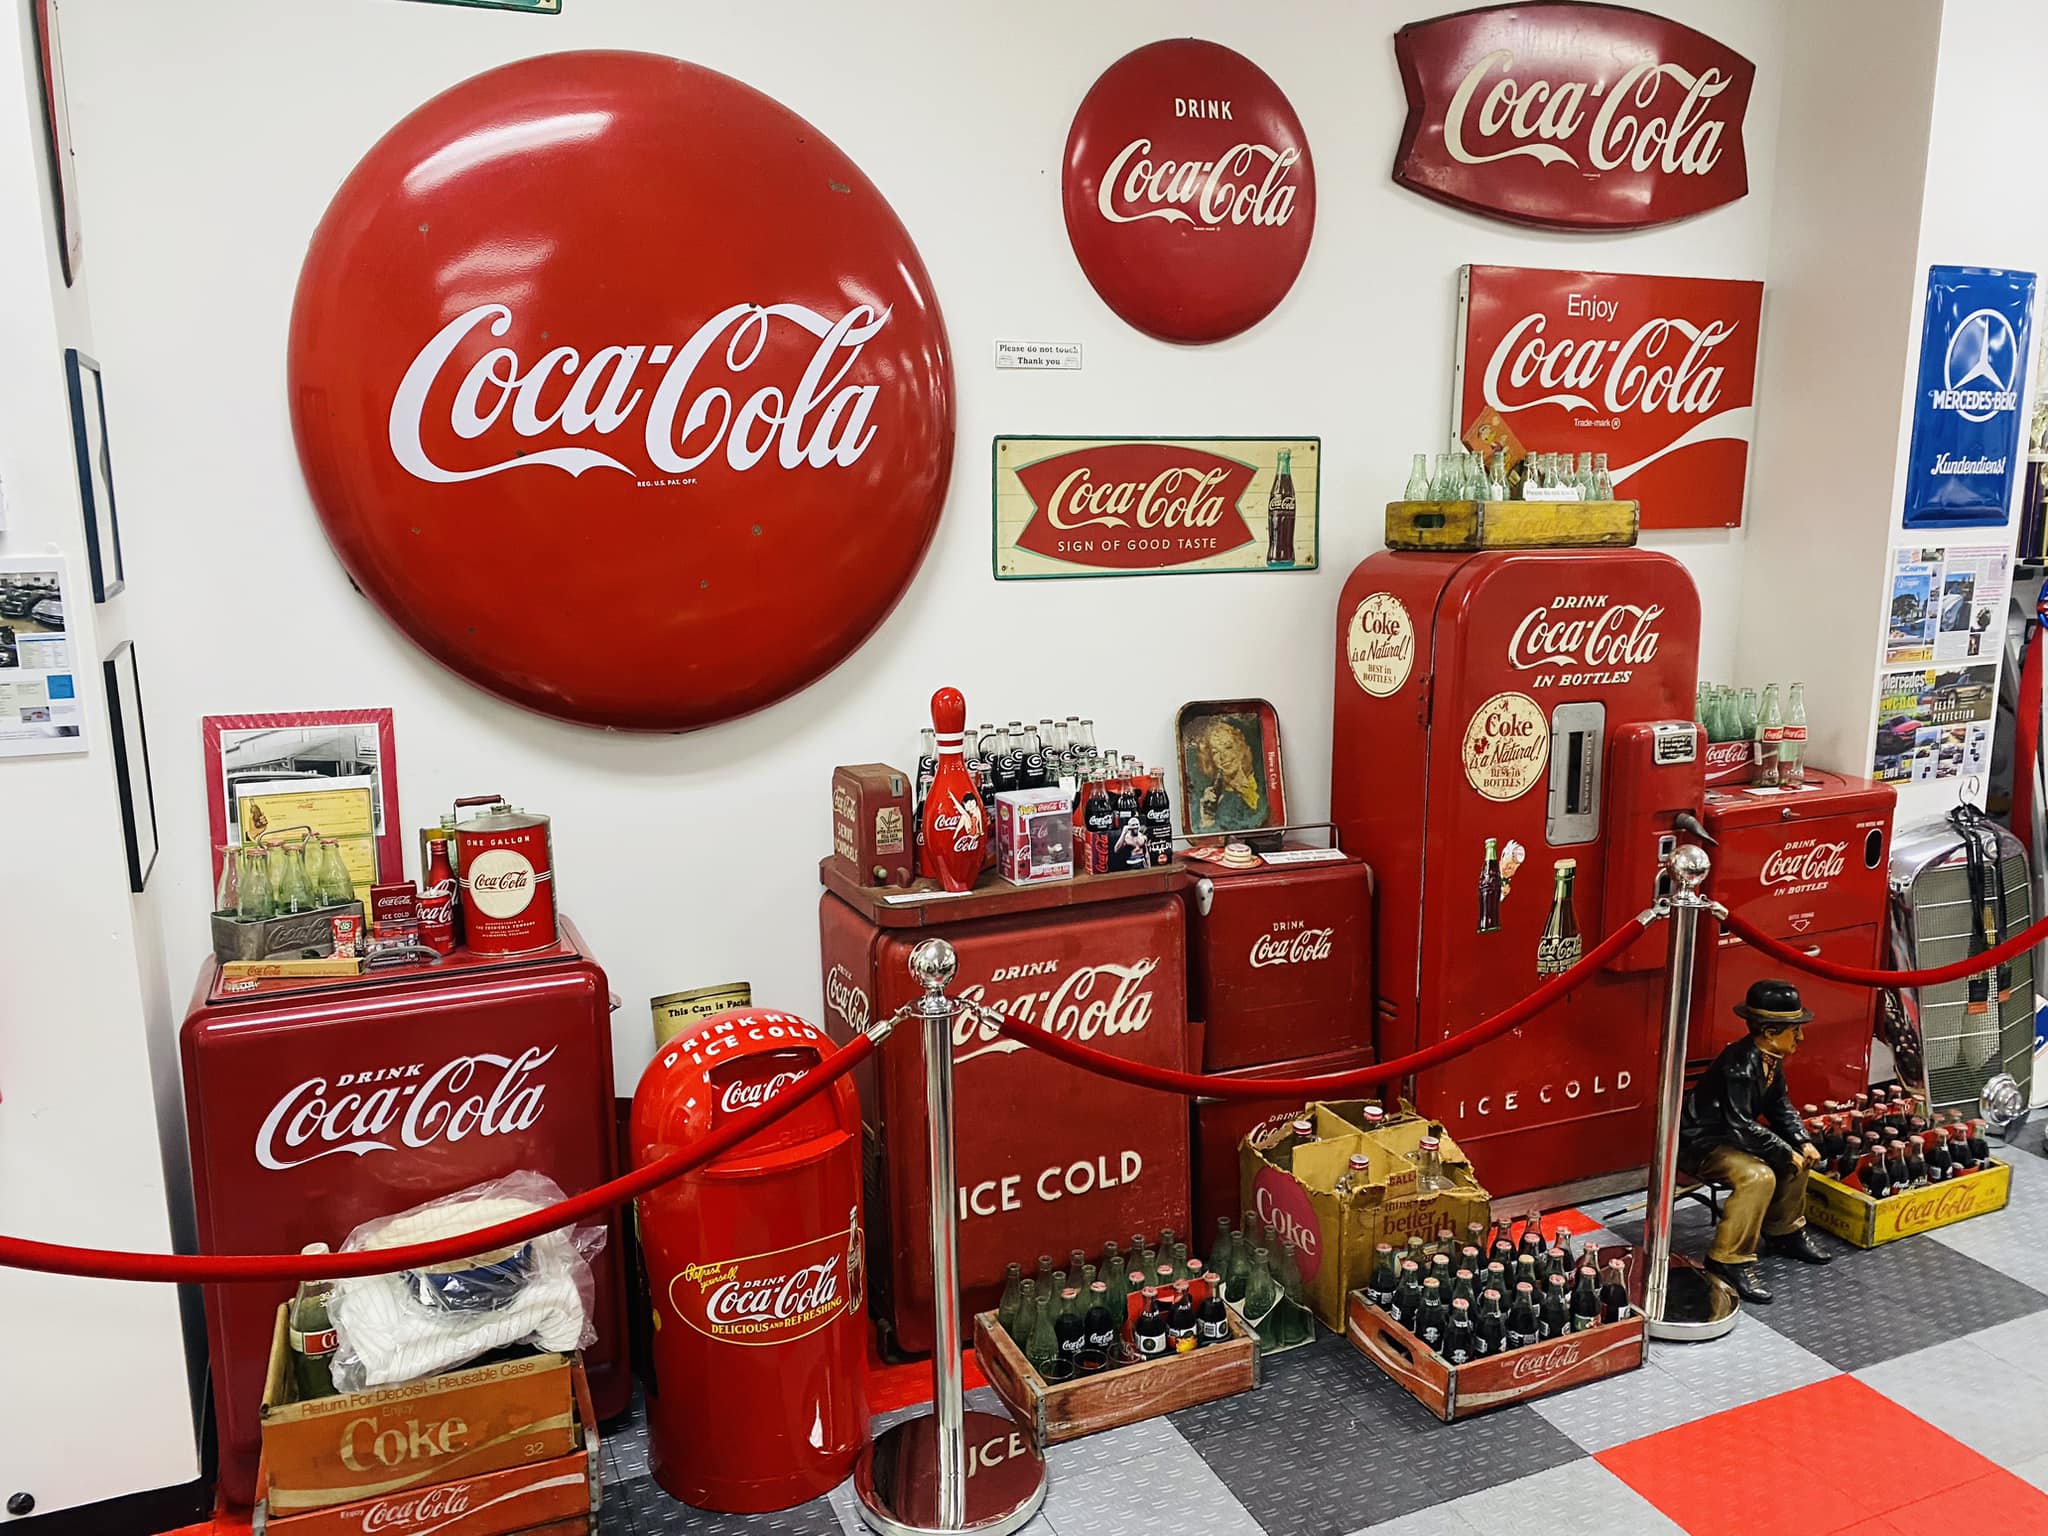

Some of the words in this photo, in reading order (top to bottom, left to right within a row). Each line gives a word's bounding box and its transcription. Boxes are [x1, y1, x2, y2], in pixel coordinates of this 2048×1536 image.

[1175, 98, 1233, 120] DRINK
[1444, 49, 1733, 176] Coca-Cola
[1098, 138, 1302, 226] Coca-Cola
[1567, 293, 1619, 322] Enjoy
[999, 344, 1025, 352] Please
[1027, 345, 1038, 353] do
[1017, 356, 1043, 365] Thank
[1045, 358, 1061, 366] you
[1482, 313, 1740, 413] Coca-Cola
[389, 303, 894, 483] Coca-Cola
[1928, 389, 2017, 411] MERCEDES-BENZ
[1931, 452, 2007, 475] Kundendienst
[1047, 467, 1233, 530] Coca-Cola
[1057, 539, 1094, 552] SIGN
[1101, 539, 1121, 551] OF
[1127, 538, 1171, 551] GOOD
[1177, 537, 1217, 550] TASTE
[1551, 595, 1608, 609] DRINK
[1362, 610, 1400, 636] Coke
[1508, 604, 1664, 670] Coca-Cola
[1351, 647, 1360, 662] is
[1360, 650, 1367, 660] a
[1368, 664, 1383, 673] BEST
[1533, 674, 1556, 688] IN
[1559, 671, 1633, 687] BOTTLES
[1485, 712, 1533, 737] Coke
[1470, 754, 1479, 769] is
[1480, 754, 1489, 767] a
[466, 839, 484, 847] ONE
[490, 835, 531, 846] GALLON
[1784, 839, 1817, 850] DRINK
[1760, 841, 1848, 886] Coca-Cola
[475, 870, 529, 891] Coca-Cola
[1774, 888, 1785, 897] IN
[1788, 882, 1829, 895] BOTTLES
[382, 912, 393, 920] ICE
[394, 911, 410, 919] COLD
[1273, 920, 1305, 932] DRINK
[1250, 928, 1335, 968] Coca-Cola
[991, 959, 1059, 983] DRINK
[668, 1008, 689, 1018] This
[692, 1004, 712, 1013] Can
[715, 1002, 724, 1011] is
[663, 1017, 758, 1069] DRINK
[692, 1034, 739, 1065] ICE
[749, 1026, 818, 1041] COLD
[336, 1063, 425, 1087] DRINK
[255, 1044, 558, 1170] Coca-Cola
[1459, 1089, 1520, 1119] ICE
[1539, 1071, 1632, 1104] COLD
[960, 1174, 1021, 1220] ICE
[1036, 1150, 1143, 1201] COLD
[1895, 1182, 1979, 1233] Coca-Cola
[1257, 1187, 1316, 1256] Coke
[1383, 1211, 1436, 1235] better
[685, 1263, 720, 1282] Refresh
[701, 1265, 739, 1294] yourself
[743, 1274, 787, 1289] DRINK
[706, 1253, 840, 1325] Coca-Cola
[711, 1322, 769, 1335] DELICIOUS
[769, 1322, 784, 1330] AND
[784, 1296, 843, 1328] REFRESHING
[1513, 1341, 1583, 1379] Coca-Cola
[302, 1400, 348, 1417] Return
[351, 1393, 372, 1406] For
[501, 1360, 535, 1376] Case
[340, 1416, 469, 1473] Coke
[525, 1441, 545, 1458] 32
[362, 1484, 473, 1534] Coca-Cola
